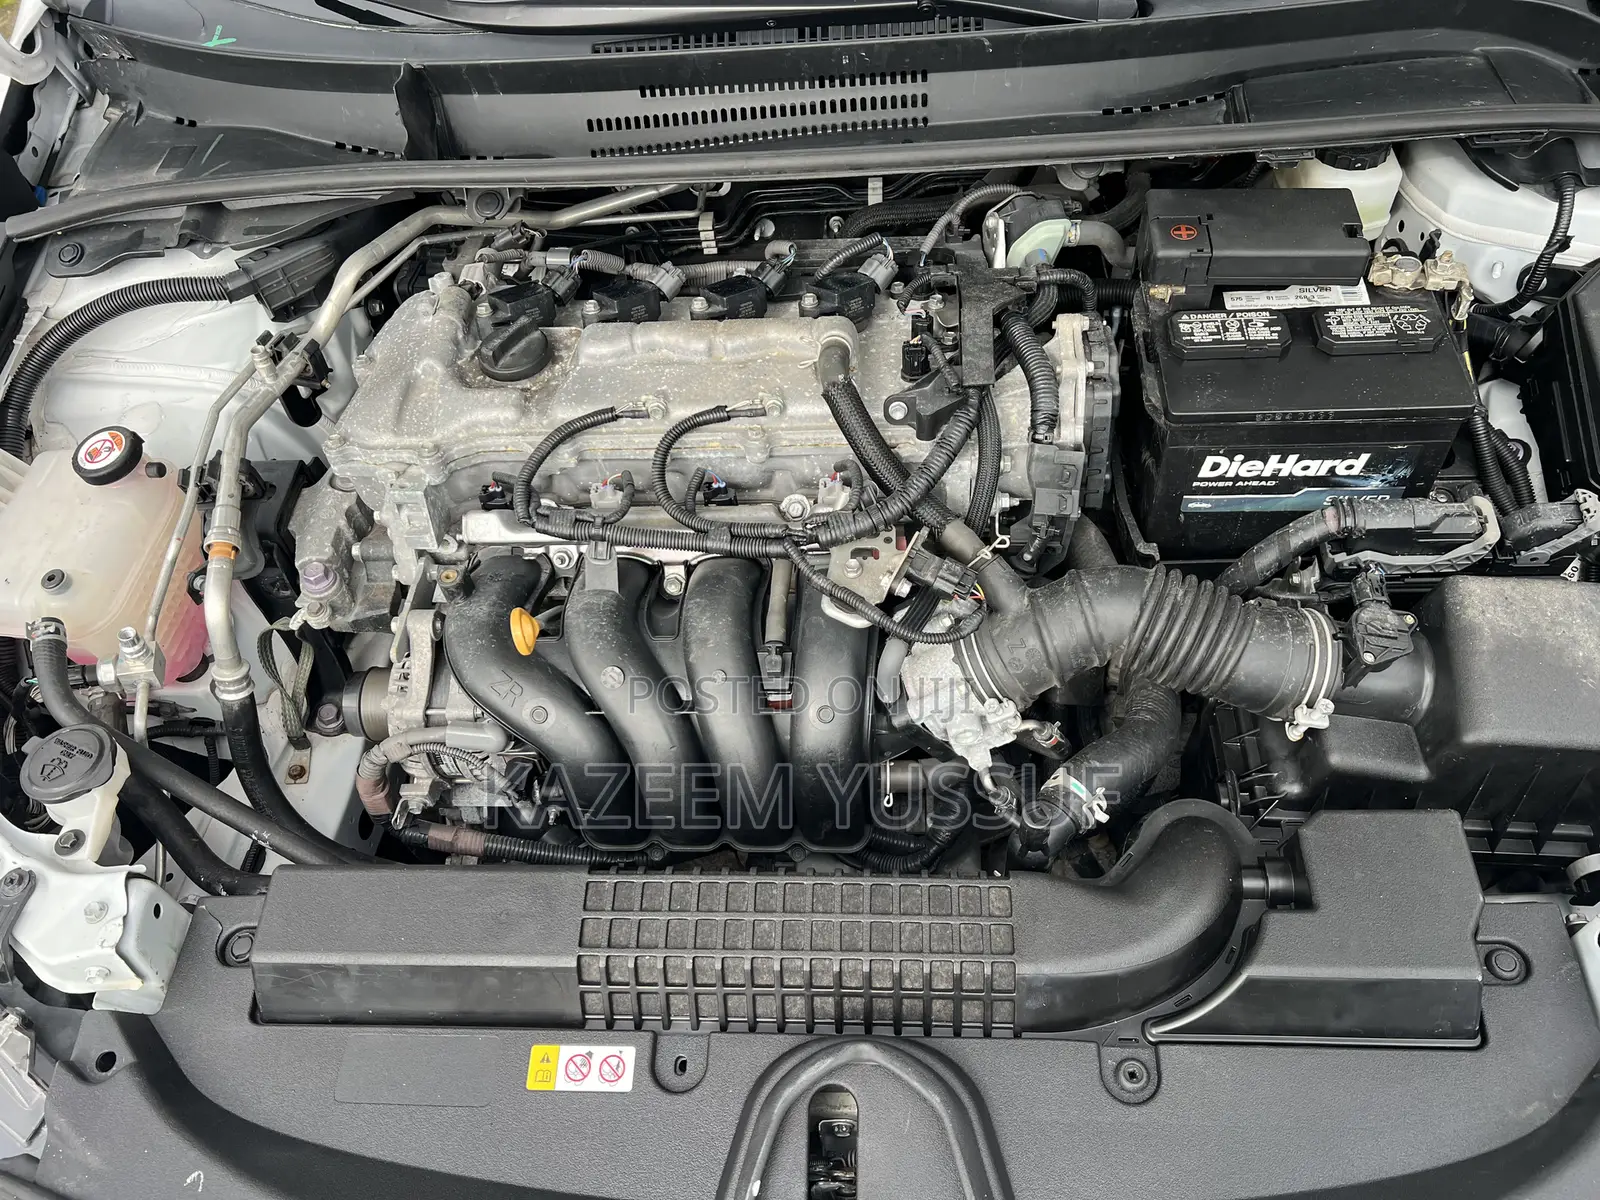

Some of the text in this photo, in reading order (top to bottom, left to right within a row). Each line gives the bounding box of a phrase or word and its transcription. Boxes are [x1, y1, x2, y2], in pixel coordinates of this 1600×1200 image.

[1190, 312, 1227, 320] DANGER
[1235, 311, 1270, 319] POISON
[1197, 452, 1372, 479] DieHard
